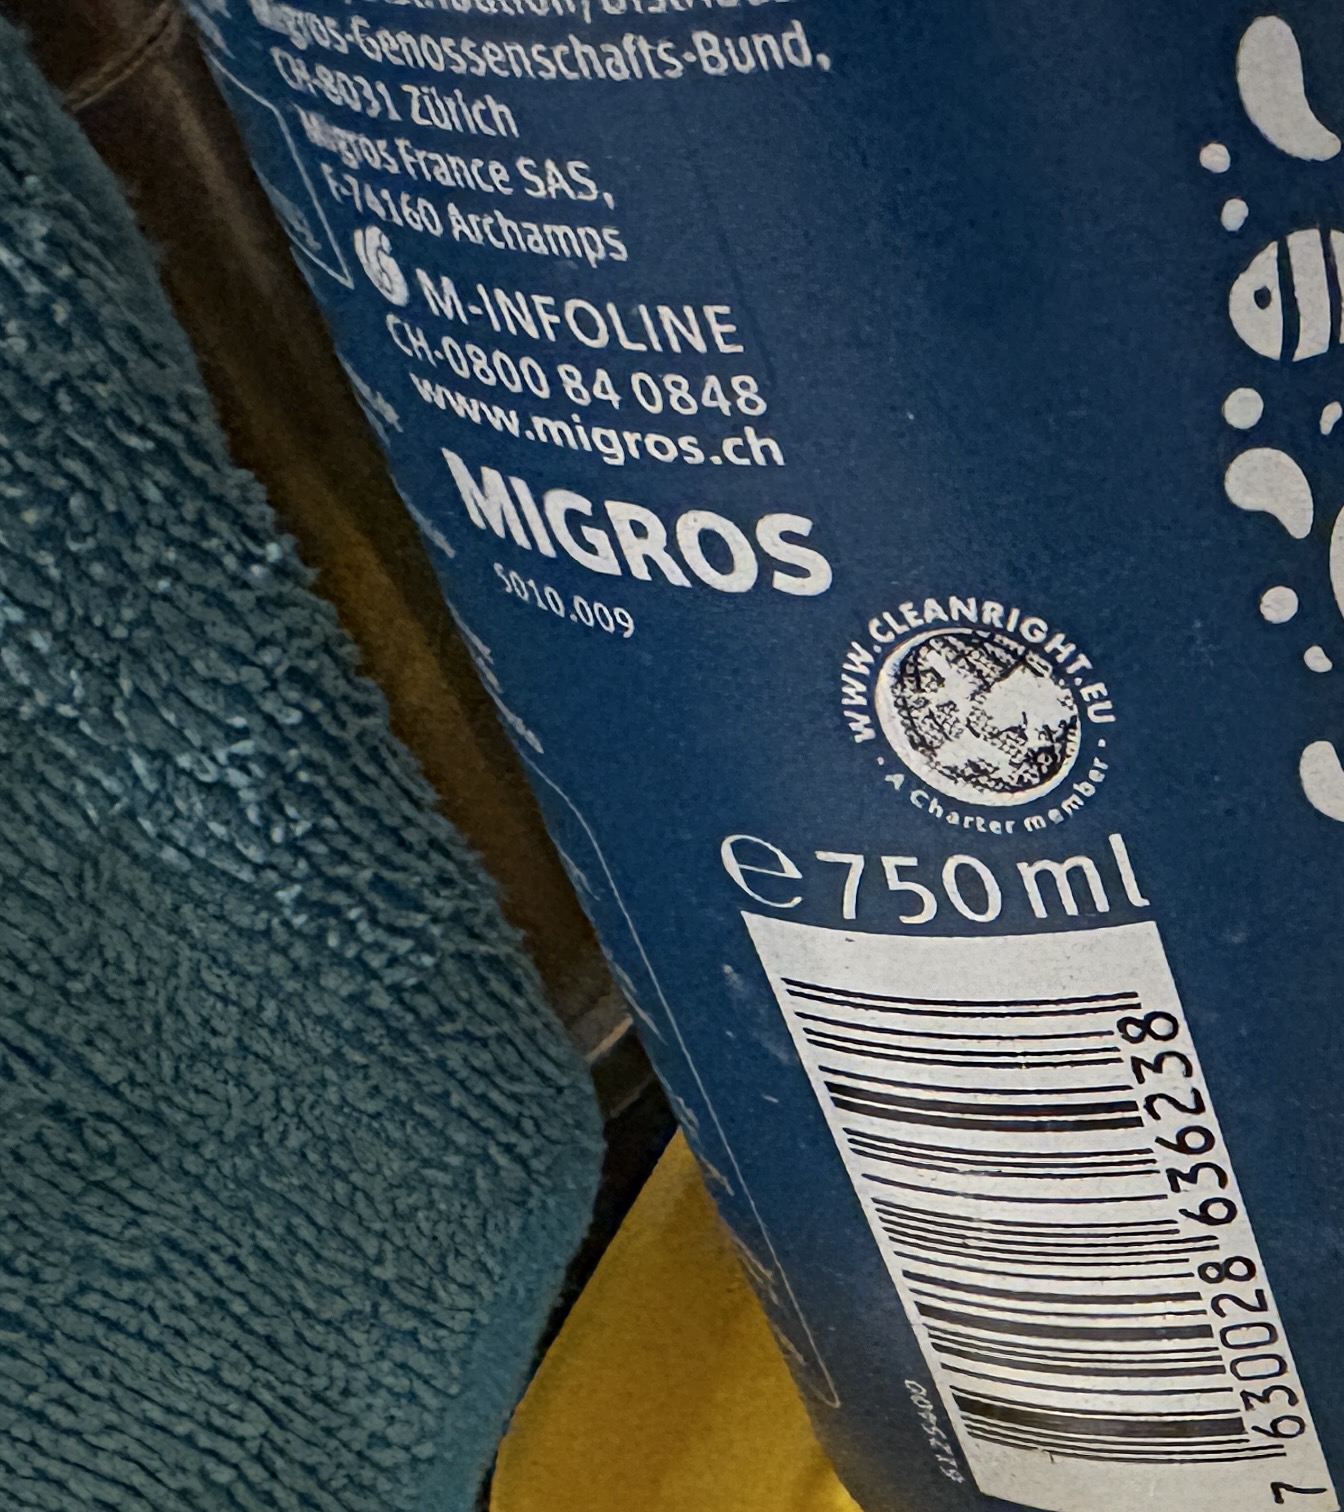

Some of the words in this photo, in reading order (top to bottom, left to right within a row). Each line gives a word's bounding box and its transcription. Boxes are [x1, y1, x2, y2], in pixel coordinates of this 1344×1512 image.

[401, 83, 520, 138] Zürich
[320, 162, 443, 237] F-74160
[447, 202, 628, 268] Archamps
[395, 137, 511, 196] France
[517, 156, 616, 209] SAS,
[415, 268, 744, 354] M-INFOLINE
[385, 314, 551, 399] CH-0800
[561, 362, 622, 409] 84
[632, 371, 767, 417] 0848
[410, 373, 785, 467] www.migros.ch
[441, 447, 833, 597] MIGROS
[840, 596, 1116, 743] WWW.CLEANRIGHT.EU
[815, 851, 1002, 924] 750
[1017, 833, 1150, 919] ml
[1116, 1010, 1237, 1226] 636238
[1198, 1255, 1306, 1440] 630028
